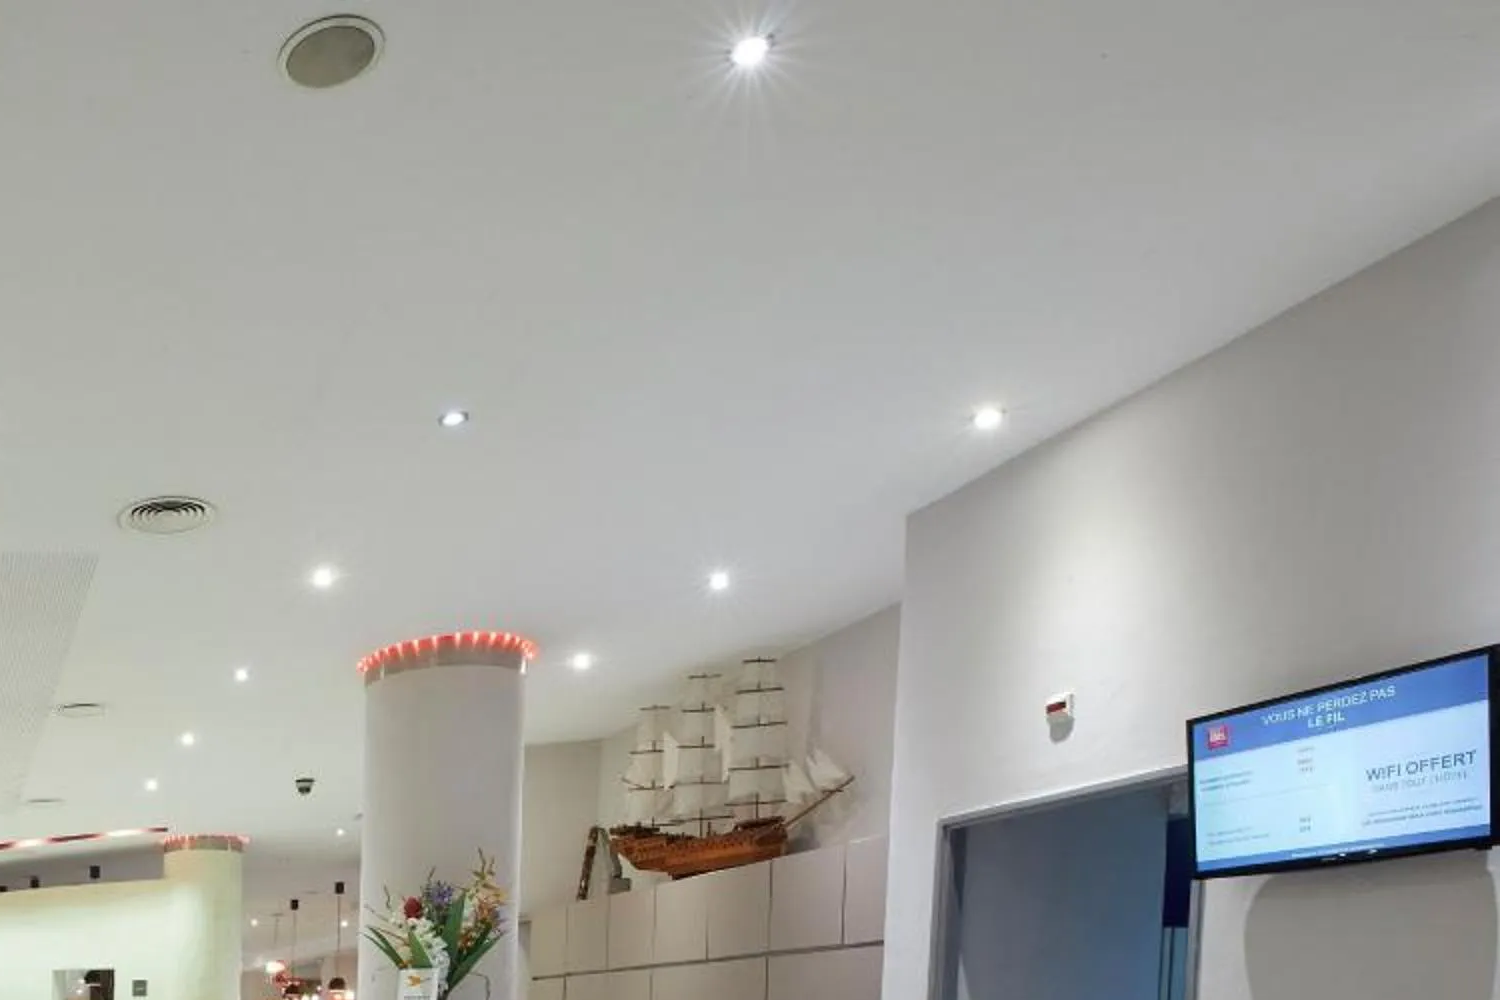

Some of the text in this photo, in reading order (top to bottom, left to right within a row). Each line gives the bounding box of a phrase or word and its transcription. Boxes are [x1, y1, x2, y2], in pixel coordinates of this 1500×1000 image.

[1261, 708, 1295, 726] VOUS
[1317, 690, 1368, 713] PERDEZ
[1370, 684, 1397, 701] PAS
[1307, 711, 1346, 729] LE FIL
[1364, 748, 1477, 782] WIFI OFFERT
